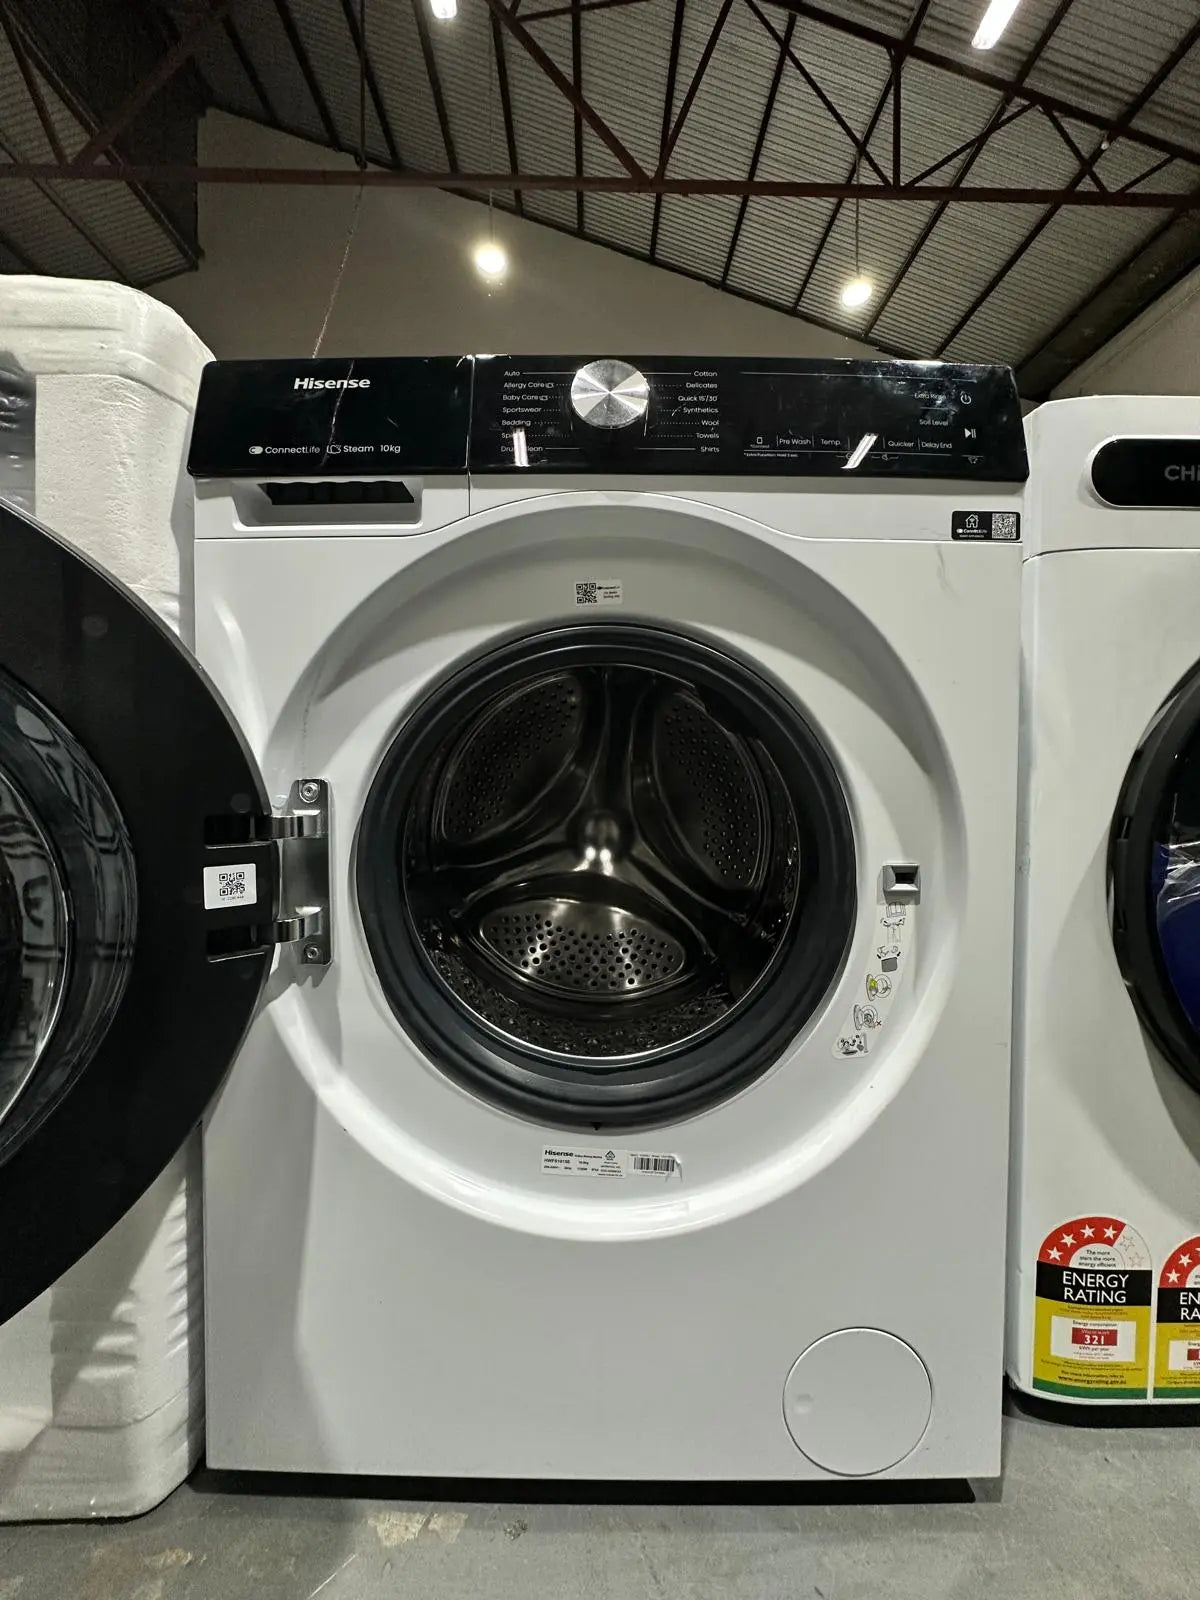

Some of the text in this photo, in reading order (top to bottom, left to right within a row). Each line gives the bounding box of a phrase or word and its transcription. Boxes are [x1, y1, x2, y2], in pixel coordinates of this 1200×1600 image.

[294, 377, 370, 389] Hisense
[502, 419, 531, 427] Bedding
[265, 444, 401, 454] ConnectLife Steam 10kg
[921, 441, 940, 449] Delay
[1062, 1271, 1129, 1287] ENERGY
[1064, 1287, 1126, 1303] RATING
[1084, 1335, 1105, 1344] 321
